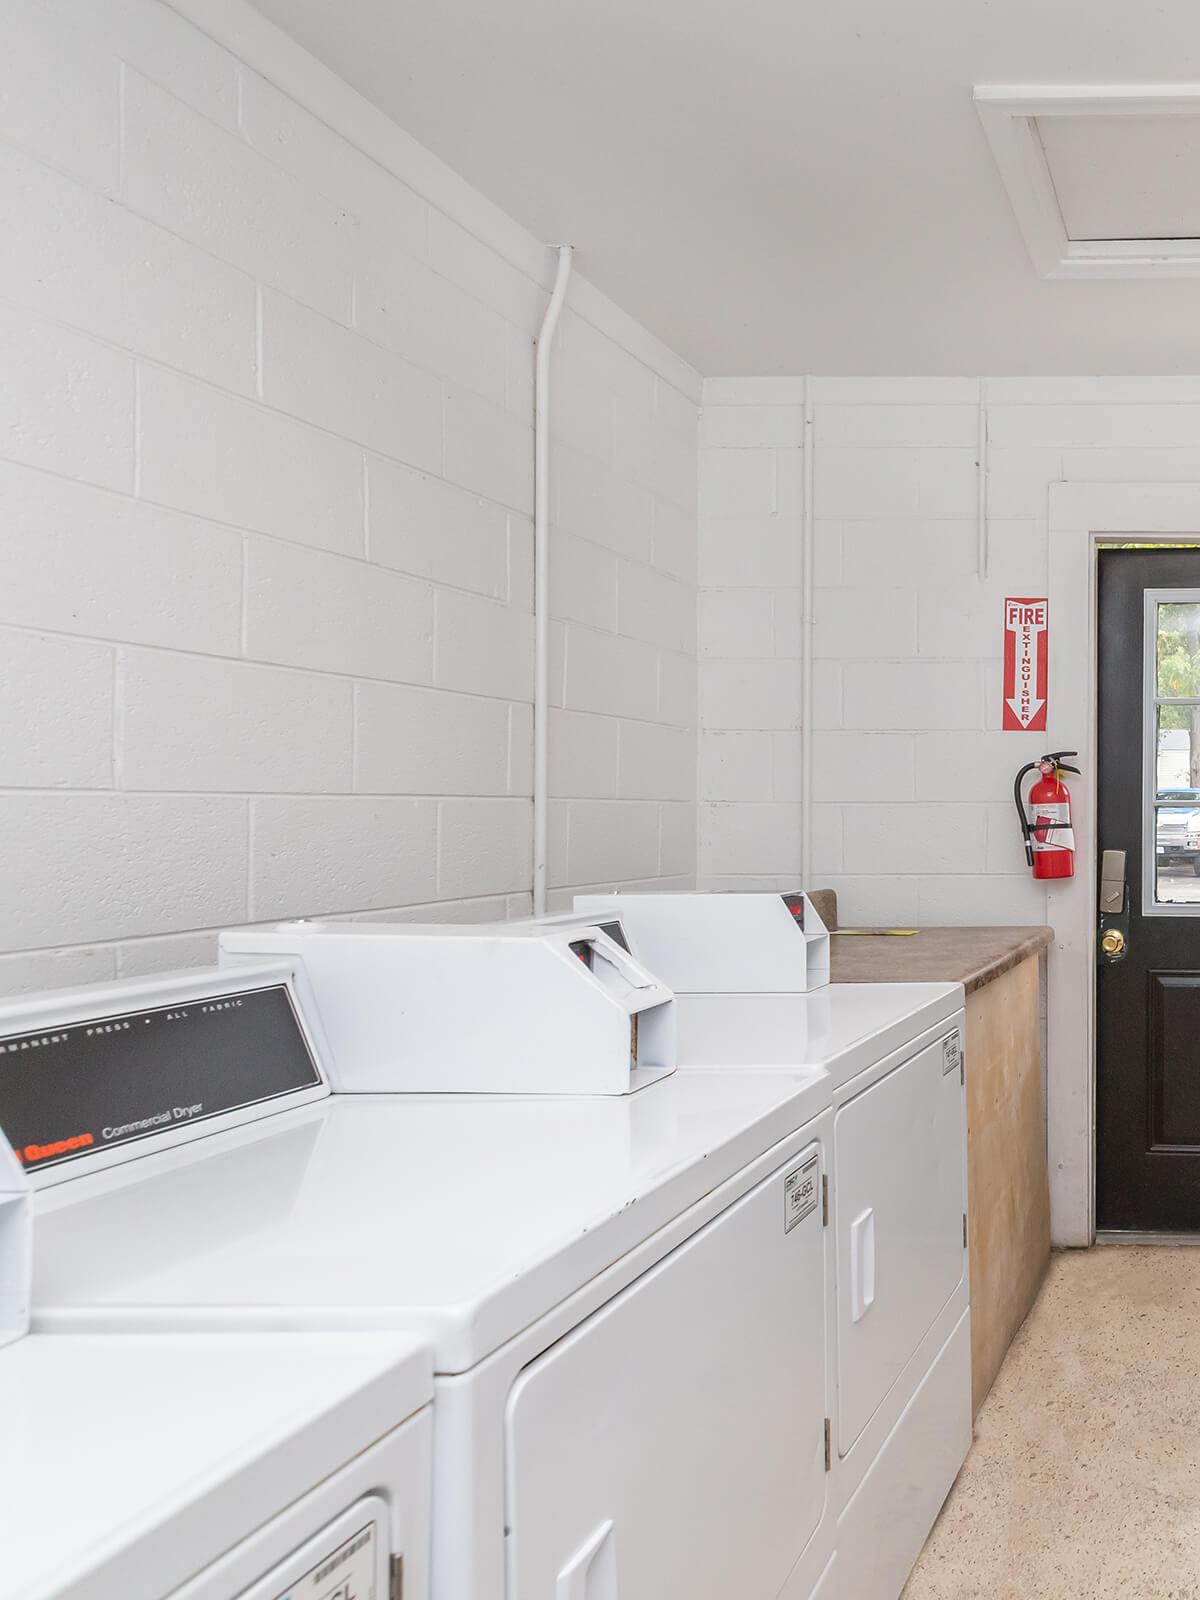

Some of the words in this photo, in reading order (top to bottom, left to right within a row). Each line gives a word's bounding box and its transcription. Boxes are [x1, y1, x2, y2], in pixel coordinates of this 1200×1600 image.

[1009, 607, 1044, 624] FIRE
[1021, 625, 1031, 721] EXTINGUISHER
[86, 1021, 131, 1037] PRESS
[166, 1010, 189, 1020] ALL
[201, 999, 244, 1014] FABRIC
[24, 1132, 94, 1162] Queen
[102, 1110, 172, 1140] Commercial
[172, 1102, 204, 1123] Dryer
